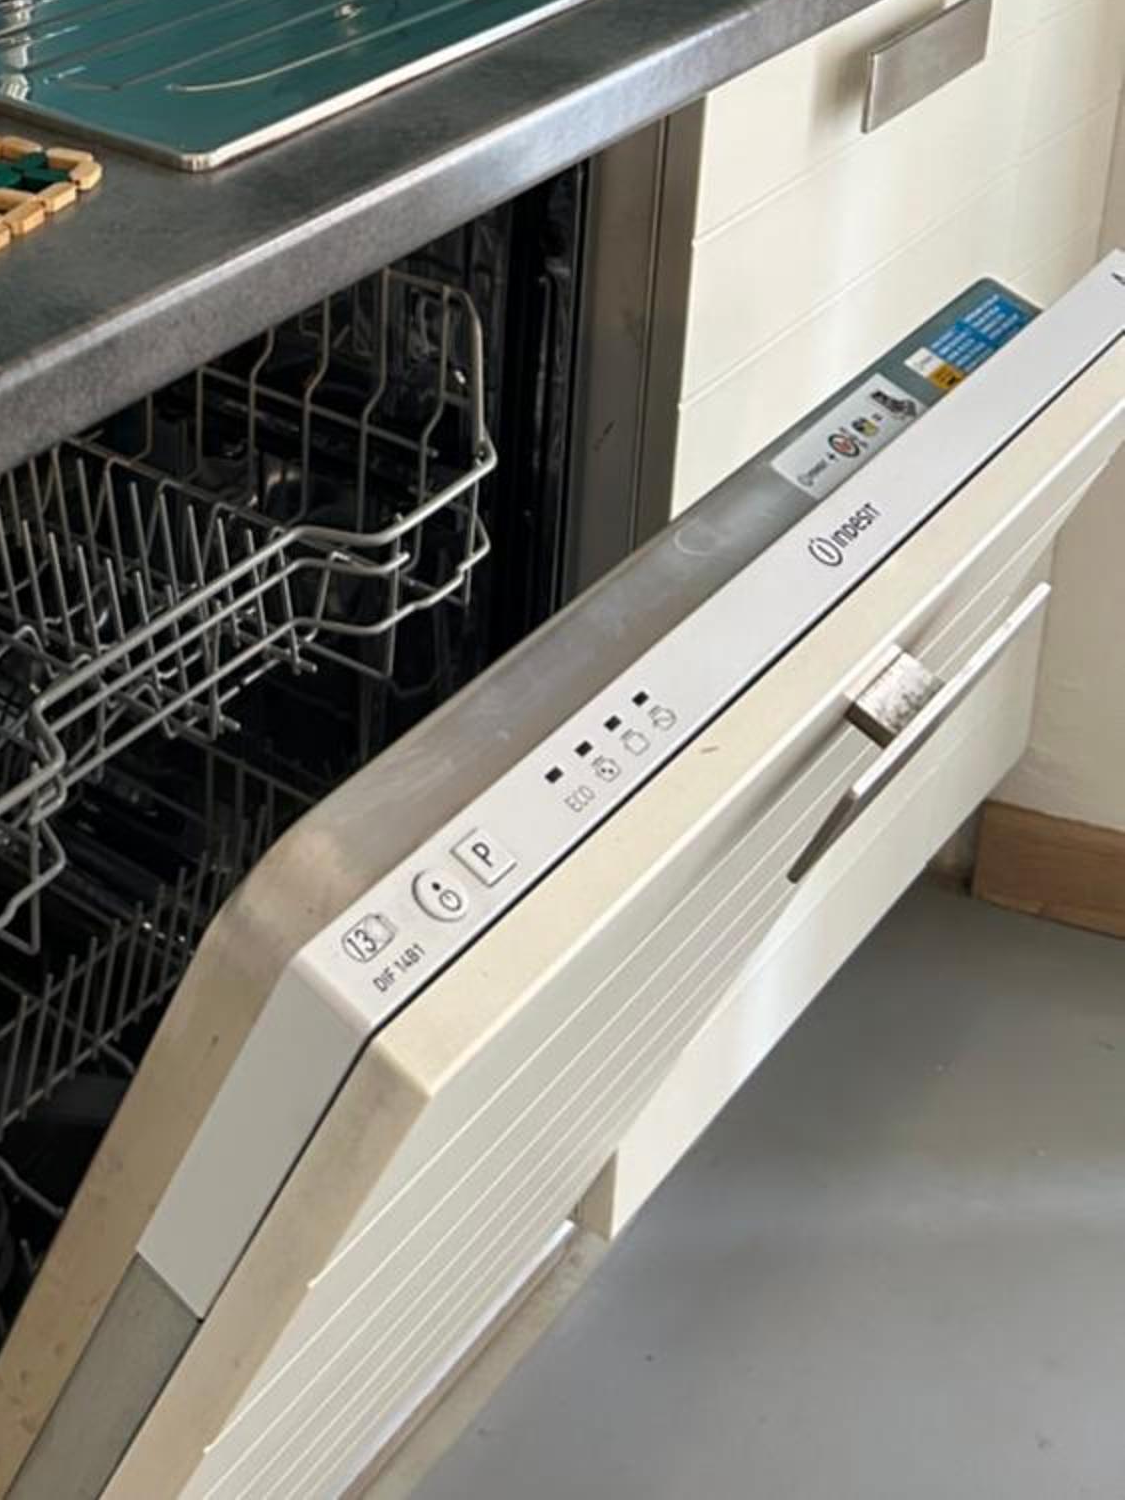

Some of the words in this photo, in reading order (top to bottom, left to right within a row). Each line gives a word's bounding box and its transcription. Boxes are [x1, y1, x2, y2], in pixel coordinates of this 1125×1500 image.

[563, 785, 596, 812] ECO
[471, 841, 494, 868] P
[372, 966, 396, 993] DIF
